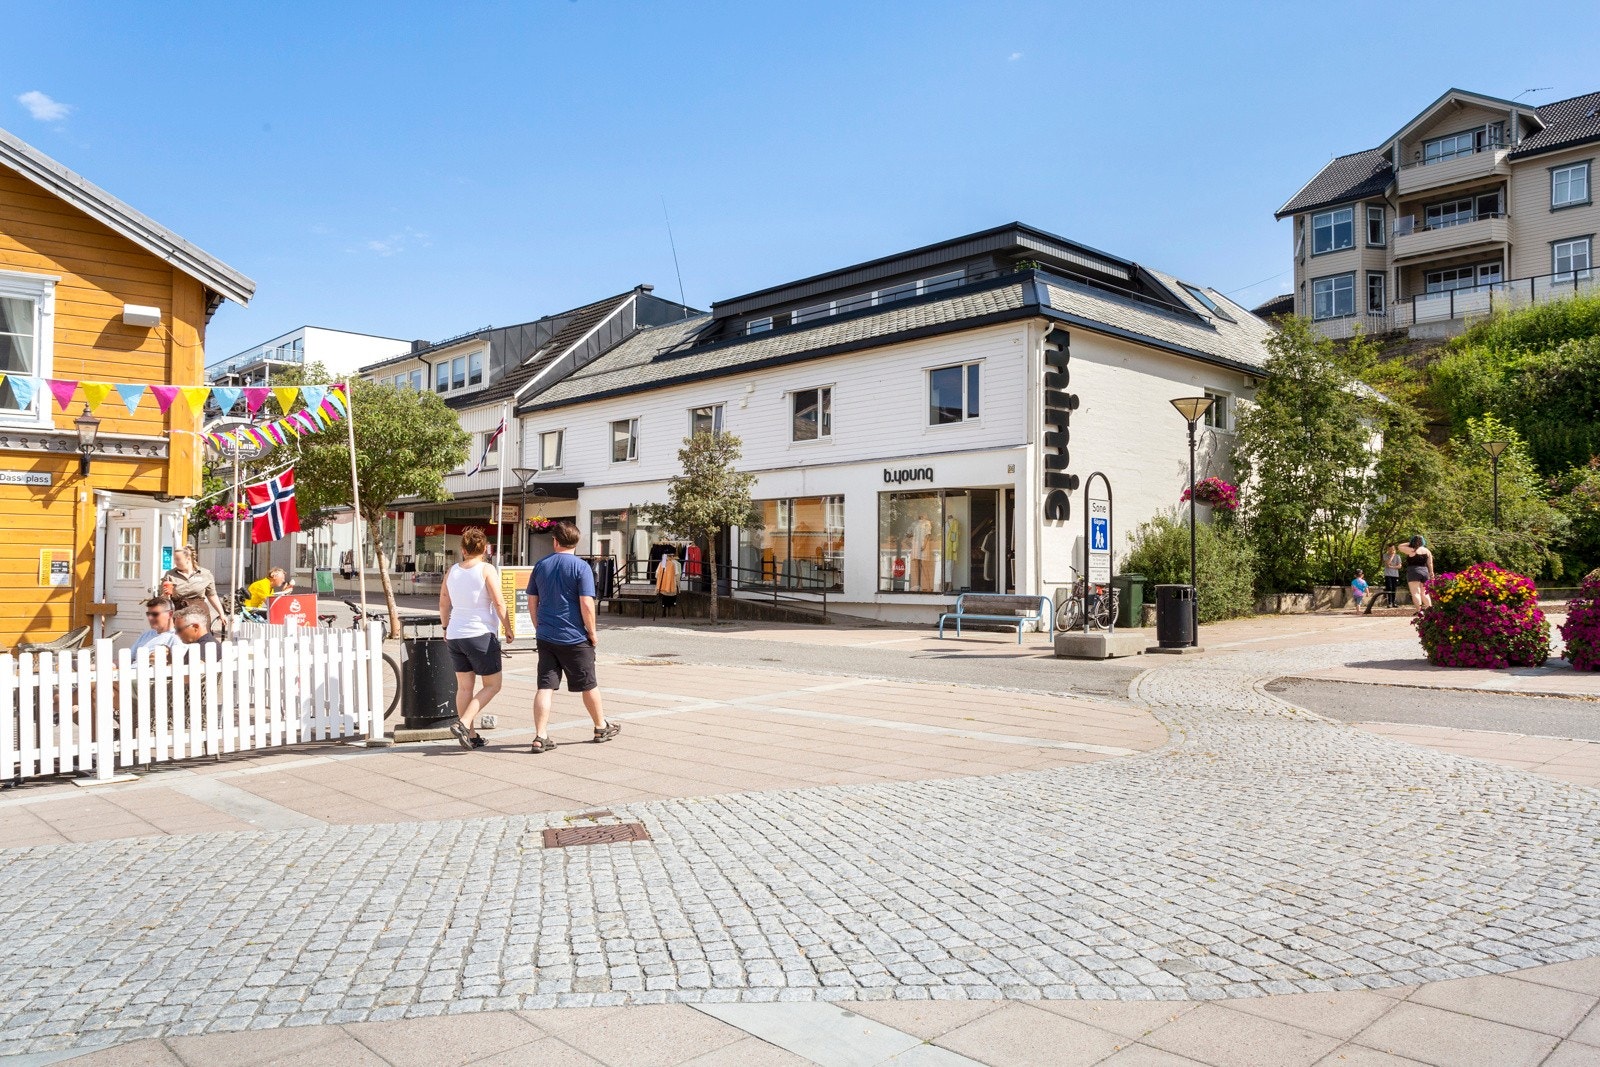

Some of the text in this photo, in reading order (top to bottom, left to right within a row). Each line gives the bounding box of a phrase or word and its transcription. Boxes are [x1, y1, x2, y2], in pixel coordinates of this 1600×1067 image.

[1044, 327, 1080, 521] mimic
[26, 475, 49, 483] plass
[883, 467, 934, 485] b.young
[1092, 502, 1107, 514] Sone
